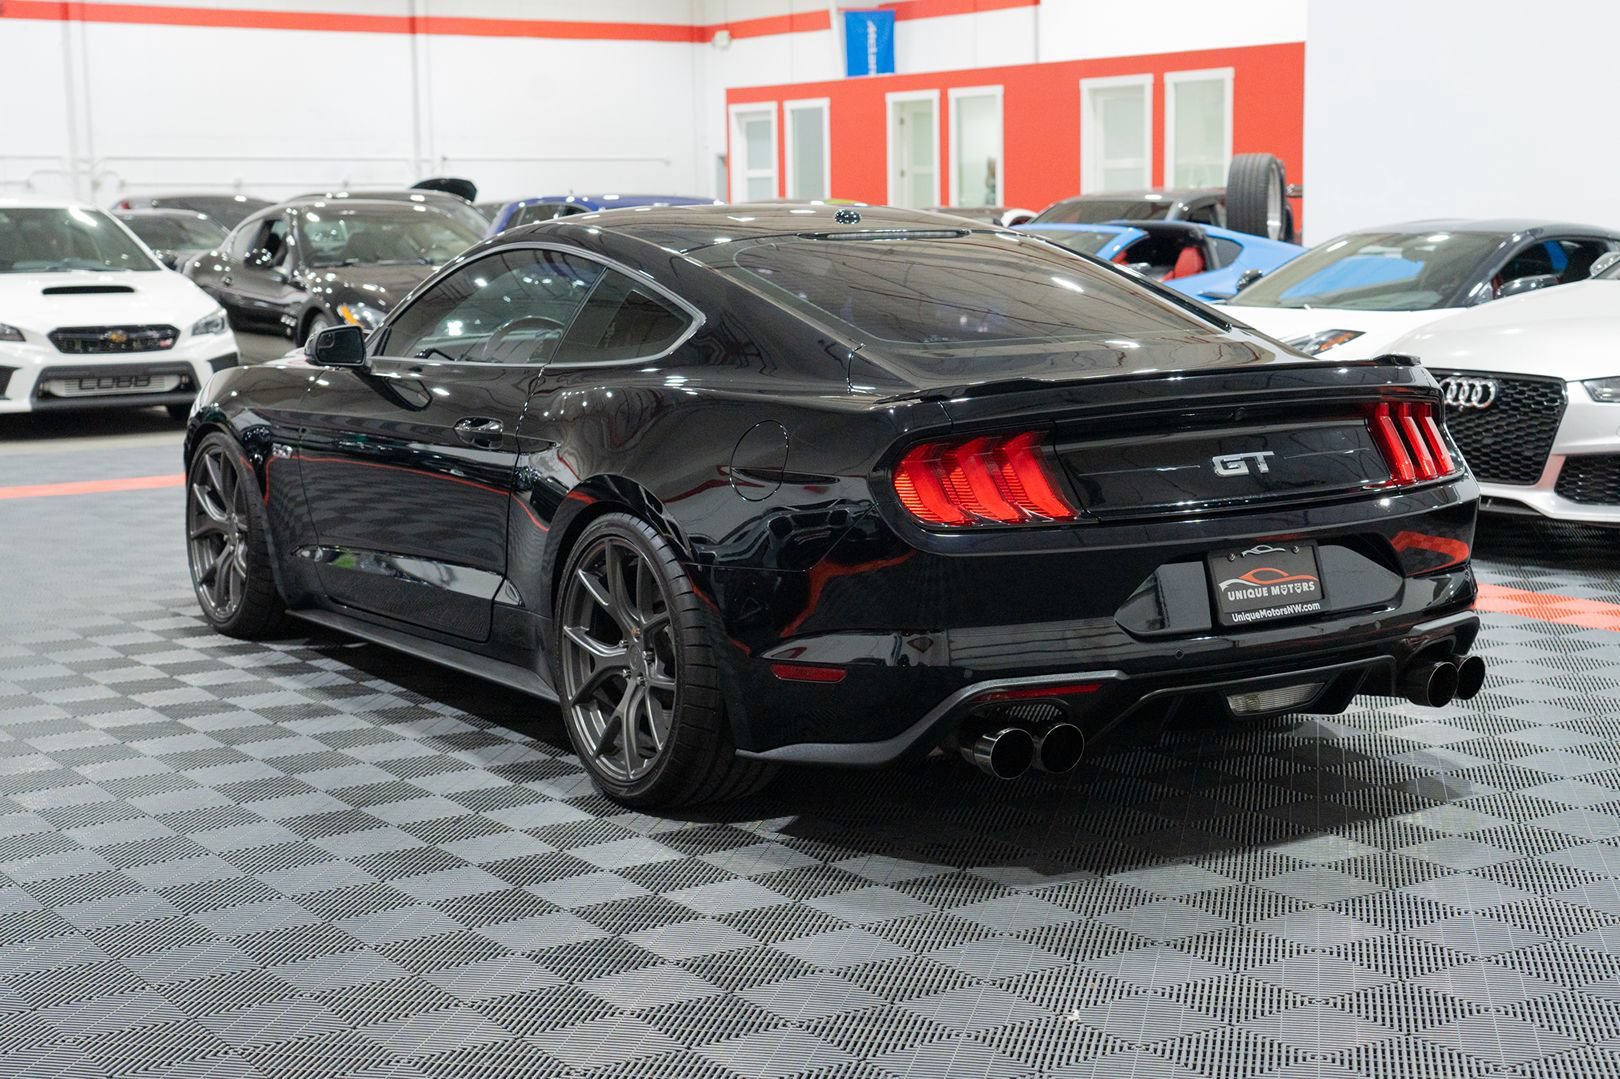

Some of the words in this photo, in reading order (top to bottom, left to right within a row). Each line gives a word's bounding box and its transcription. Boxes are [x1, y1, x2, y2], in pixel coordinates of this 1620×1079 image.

[78, 375, 151, 390] COBB
[1211, 451, 1275, 477] GT
[1227, 587, 1269, 601] UNIQUE
[1271, 581, 1316, 595] MOTORS
[1231, 602, 1321, 622] UniqueMotorsNW.com
